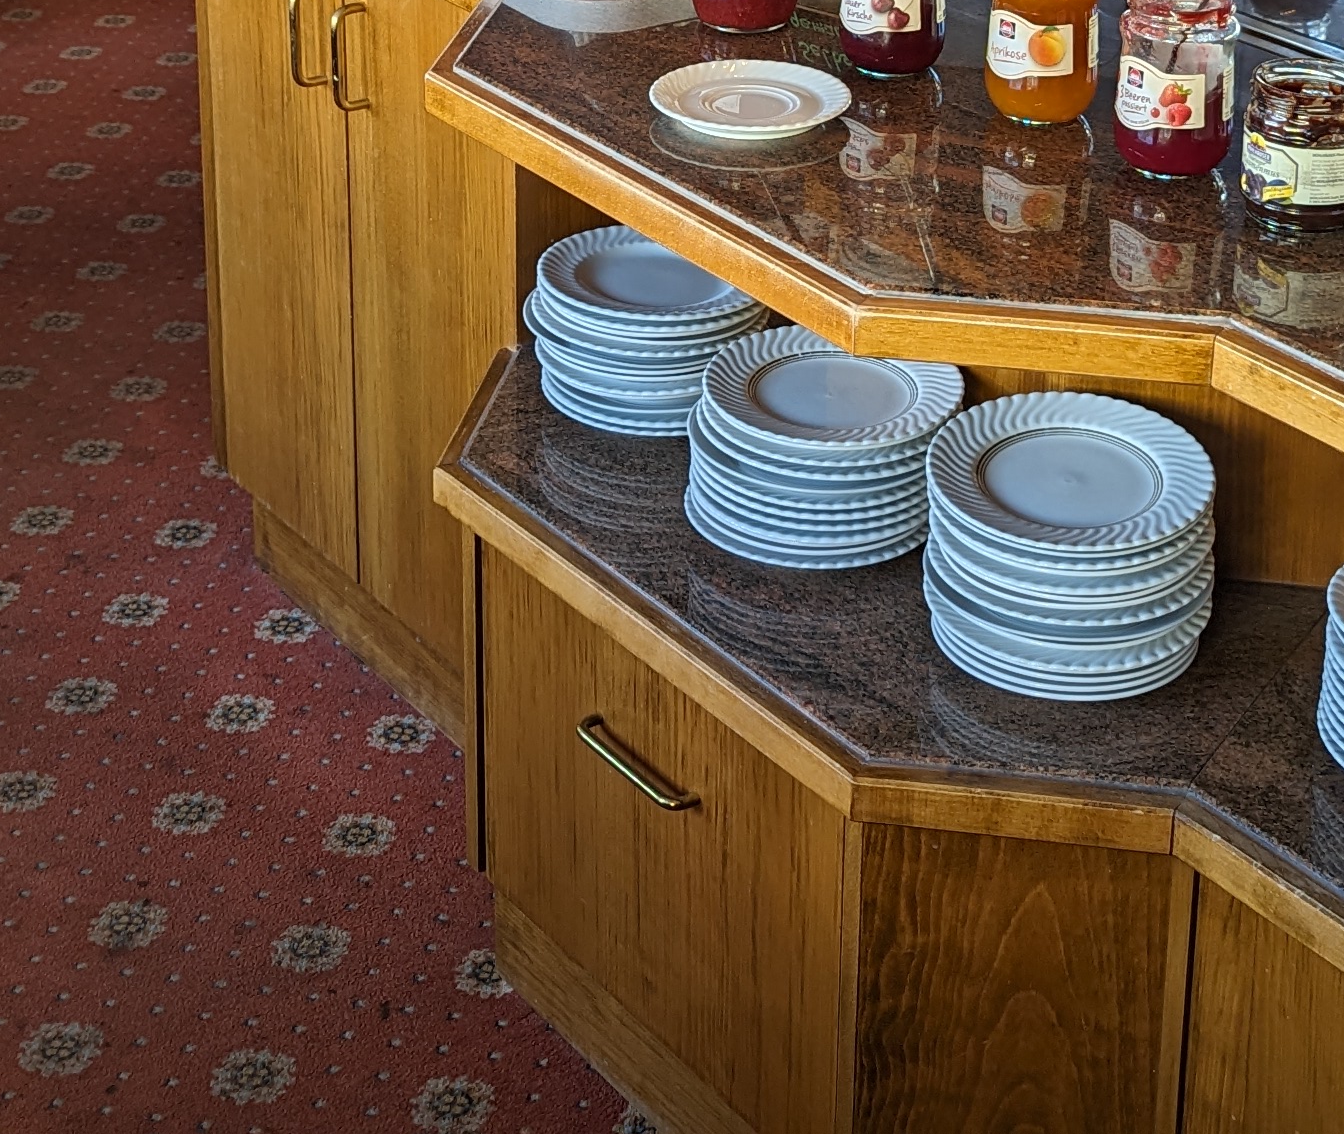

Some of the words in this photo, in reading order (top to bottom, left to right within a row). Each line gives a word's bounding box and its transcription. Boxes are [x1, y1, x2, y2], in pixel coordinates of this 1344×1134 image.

[846, 6, 873, 22] Kirsche
[991, 41, 1027, 61] Aprikose
[1124, 87, 1152, 105] Beeren
